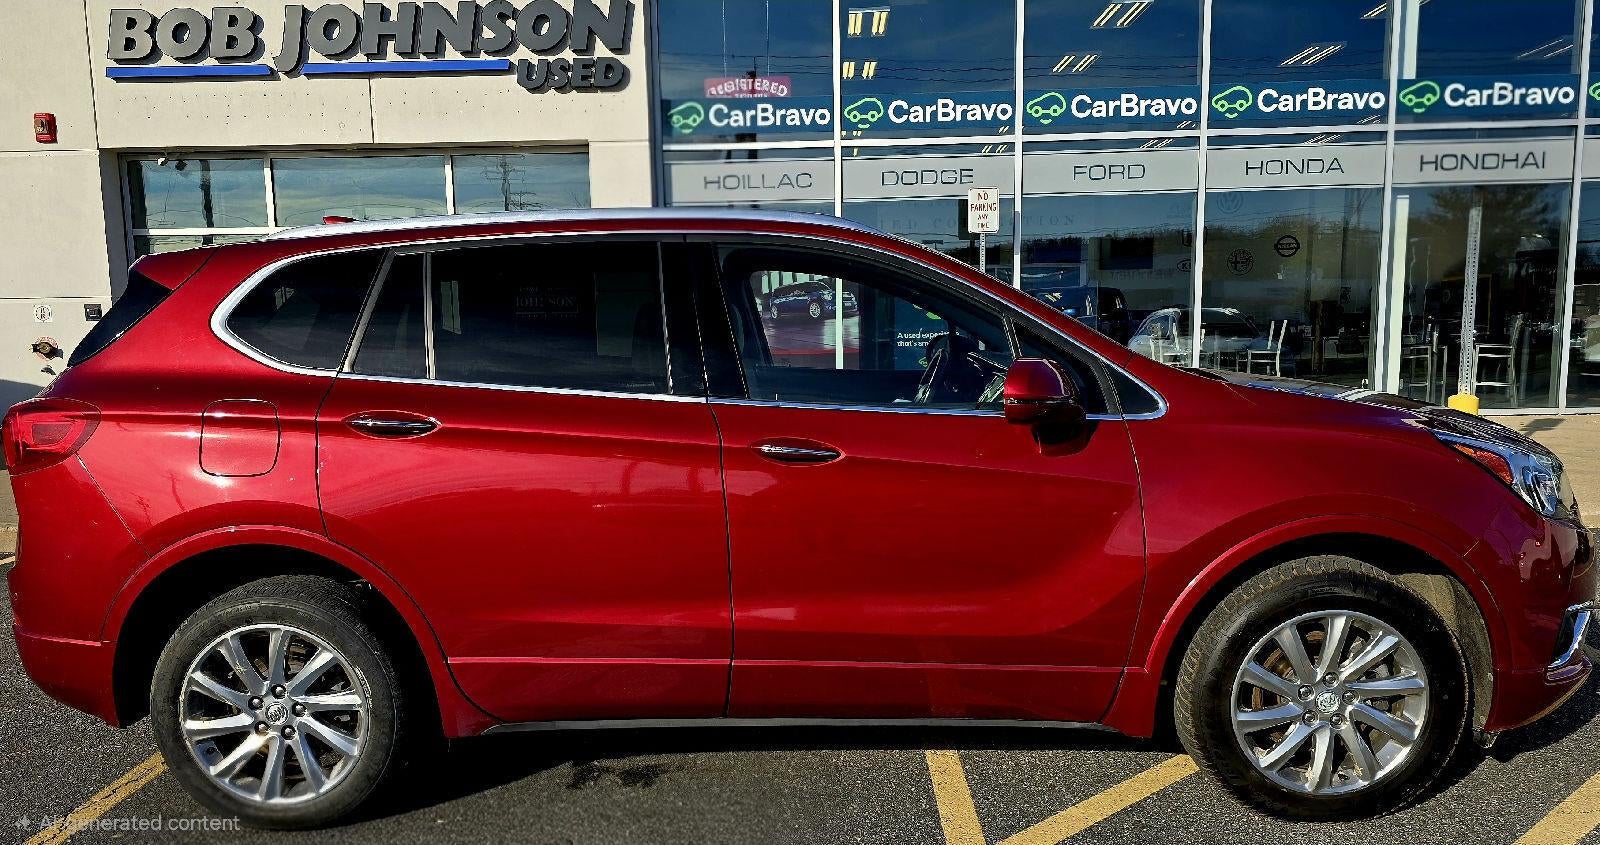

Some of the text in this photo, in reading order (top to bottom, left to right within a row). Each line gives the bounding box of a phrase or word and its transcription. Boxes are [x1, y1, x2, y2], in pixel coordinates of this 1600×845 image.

[107, 0, 632, 75] BOB JOHNSON
[517, 57, 628, 92] USED
[1071, 93, 1198, 119] CarBravo
[1257, 87, 1385, 112] CarBravo
[1444, 82, 1575, 108] CarBravo
[708, 103, 831, 127] CarBravo
[887, 98, 1013, 124] CarBravo
[1073, 163, 1146, 181] FORD
[1245, 157, 1344, 176] HONDA
[1420, 151, 1546, 172] HONDHAI
[881, 168, 975, 187] DODGE
[977, 192, 989, 201] NO
[903, 331, 921, 339] used
